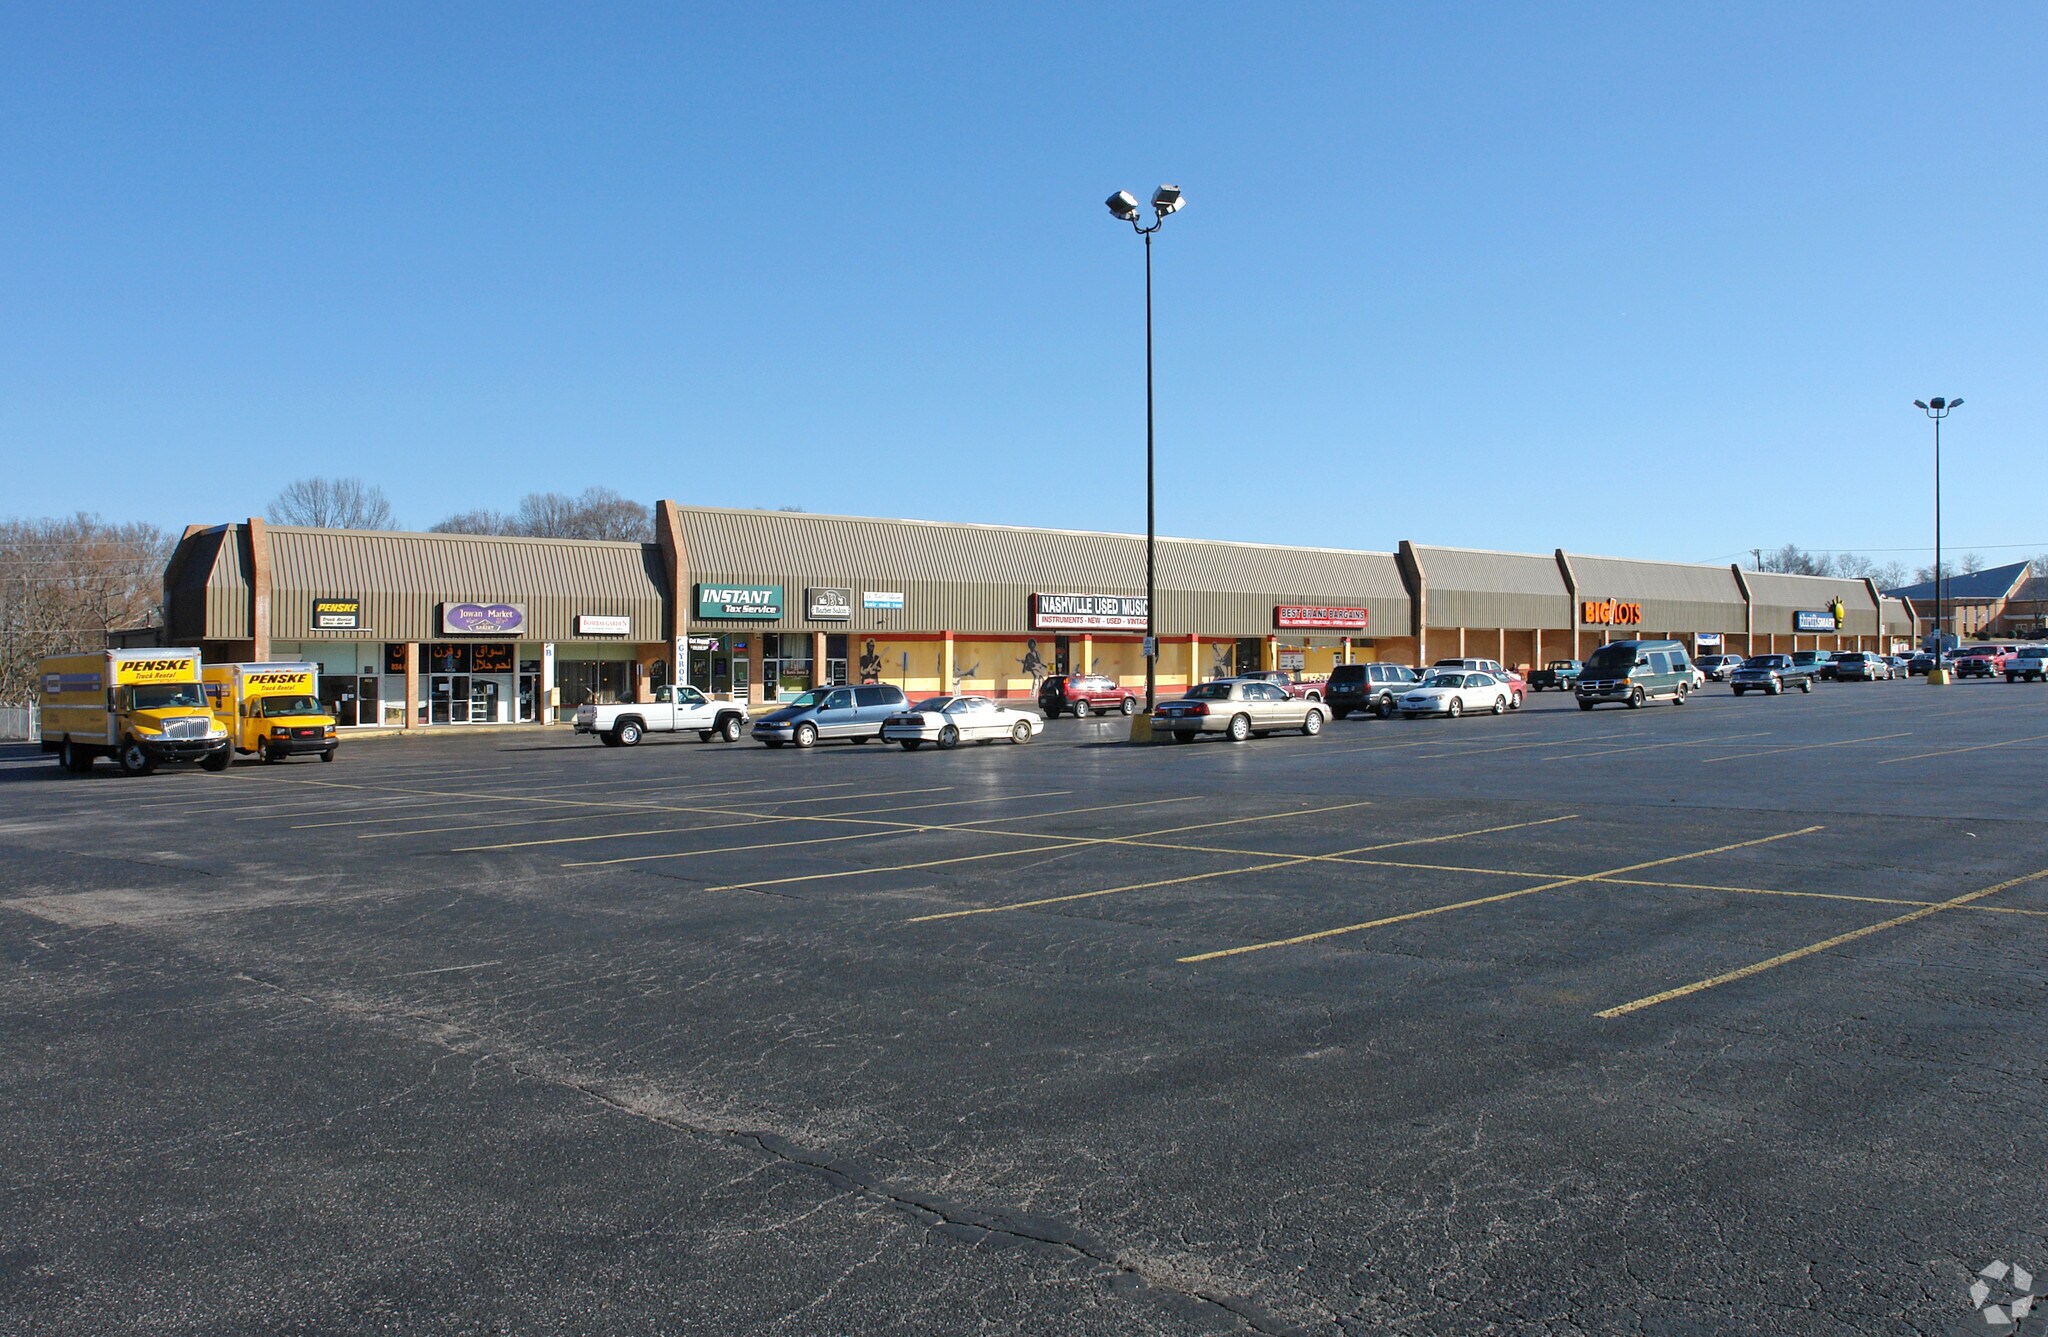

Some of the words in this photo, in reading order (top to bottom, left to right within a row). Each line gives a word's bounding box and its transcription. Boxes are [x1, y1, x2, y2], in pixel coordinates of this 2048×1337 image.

[702, 589, 773, 604] INSTANT
[317, 603, 359, 613] PENSKE
[725, 605, 742, 613] Tax
[742, 605, 777, 614] Service
[1042, 596, 1093, 614] NASHVILLE
[1095, 597, 1119, 615] USED
[460, 609, 483, 619] Jowan
[488, 609, 513, 618] Market
[1281, 607, 1301, 618] BEST
[1302, 608, 1327, 619] BRAND
[1329, 609, 1365, 619] BARGAINS
[1615, 602, 1642, 624] LOTS
[1041, 616, 1084, 624] INSTRUMENTS
[1107, 617, 1122, 625] USED
[120, 659, 191, 672] PENSKE
[248, 673, 307, 685] PENSKE
